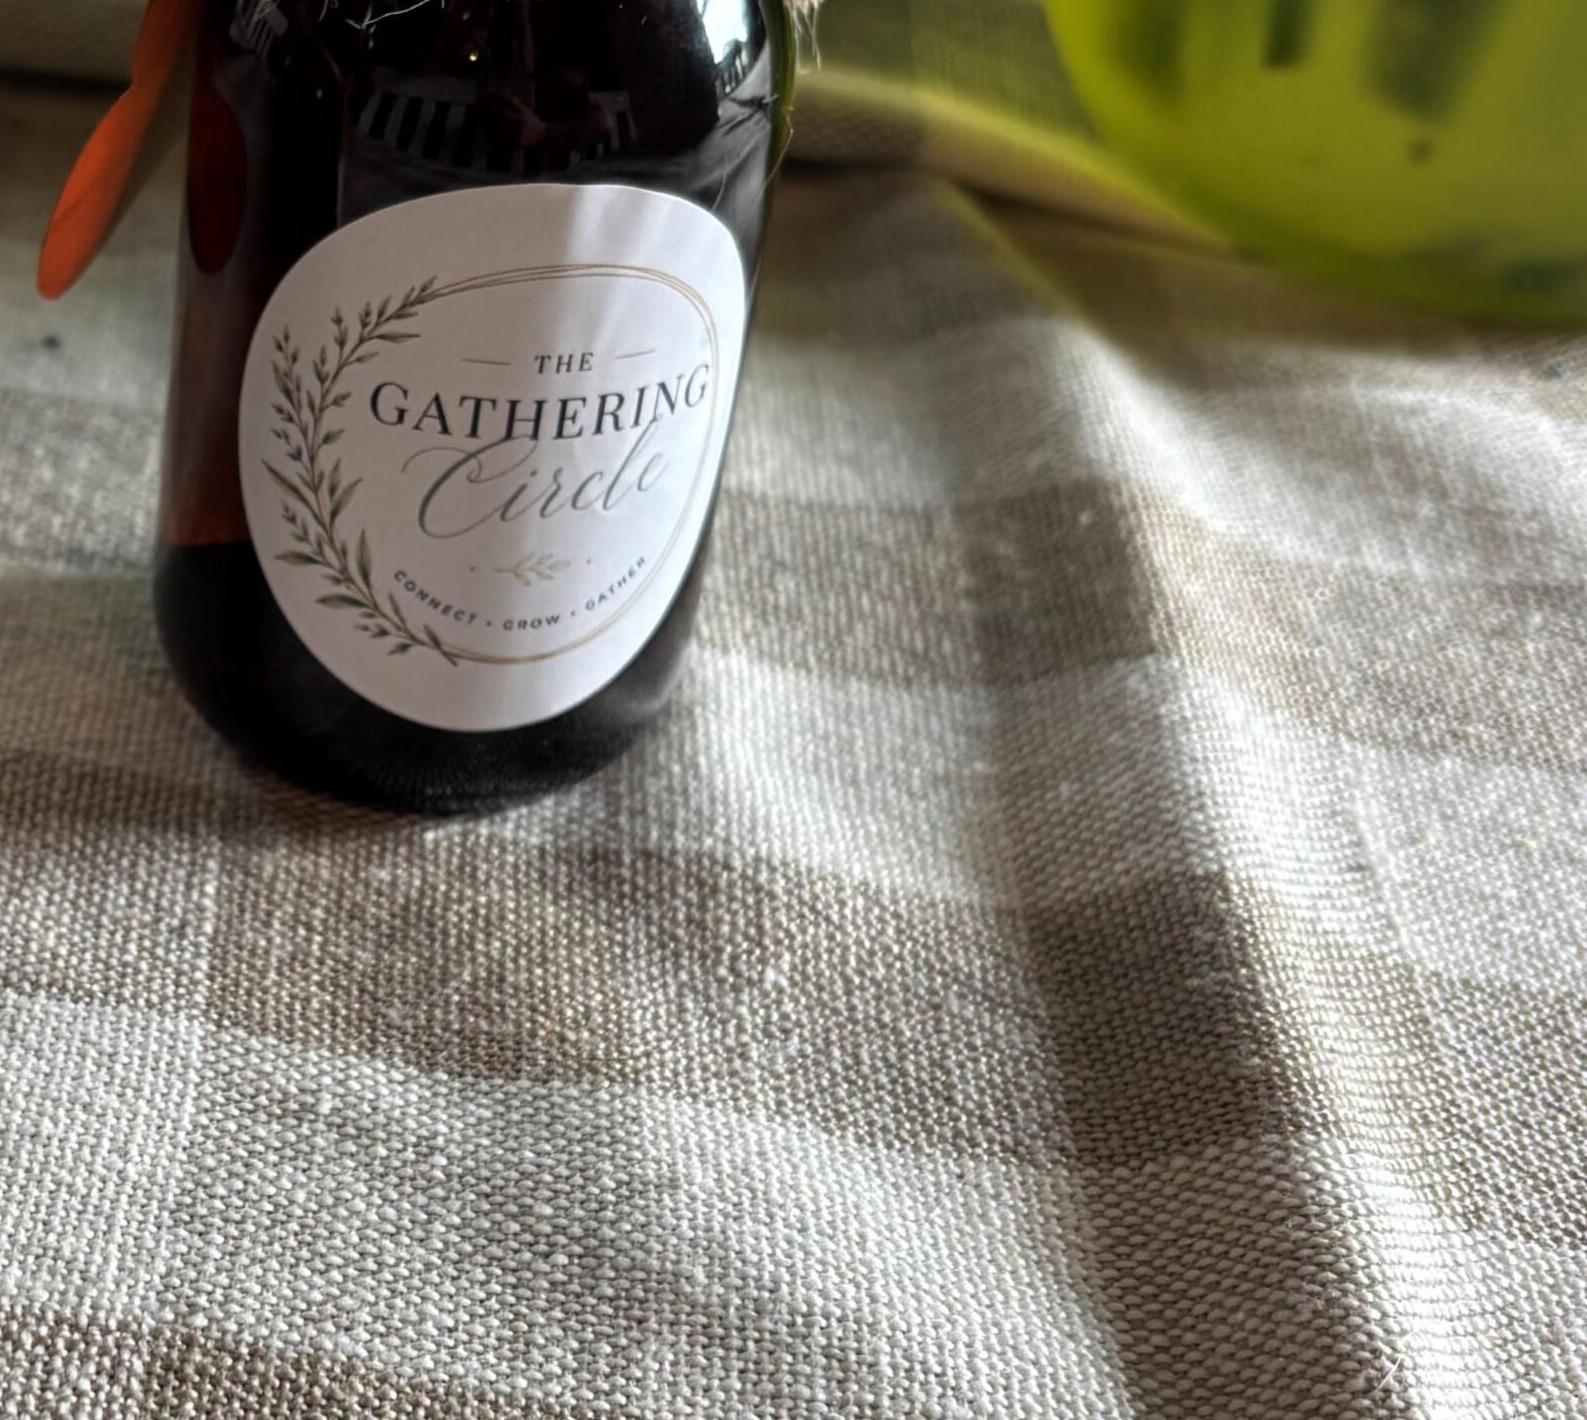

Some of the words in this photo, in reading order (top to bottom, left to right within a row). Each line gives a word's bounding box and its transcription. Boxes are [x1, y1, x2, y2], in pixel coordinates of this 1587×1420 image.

[369, 363, 710, 441] GATHERING
[534, 352, 595, 376] THE
[402, 418, 670, 539] Circle
[394, 570, 477, 626] CONNECT
[502, 612, 562, 632] GROW
[585, 555, 648, 612] GATHER
